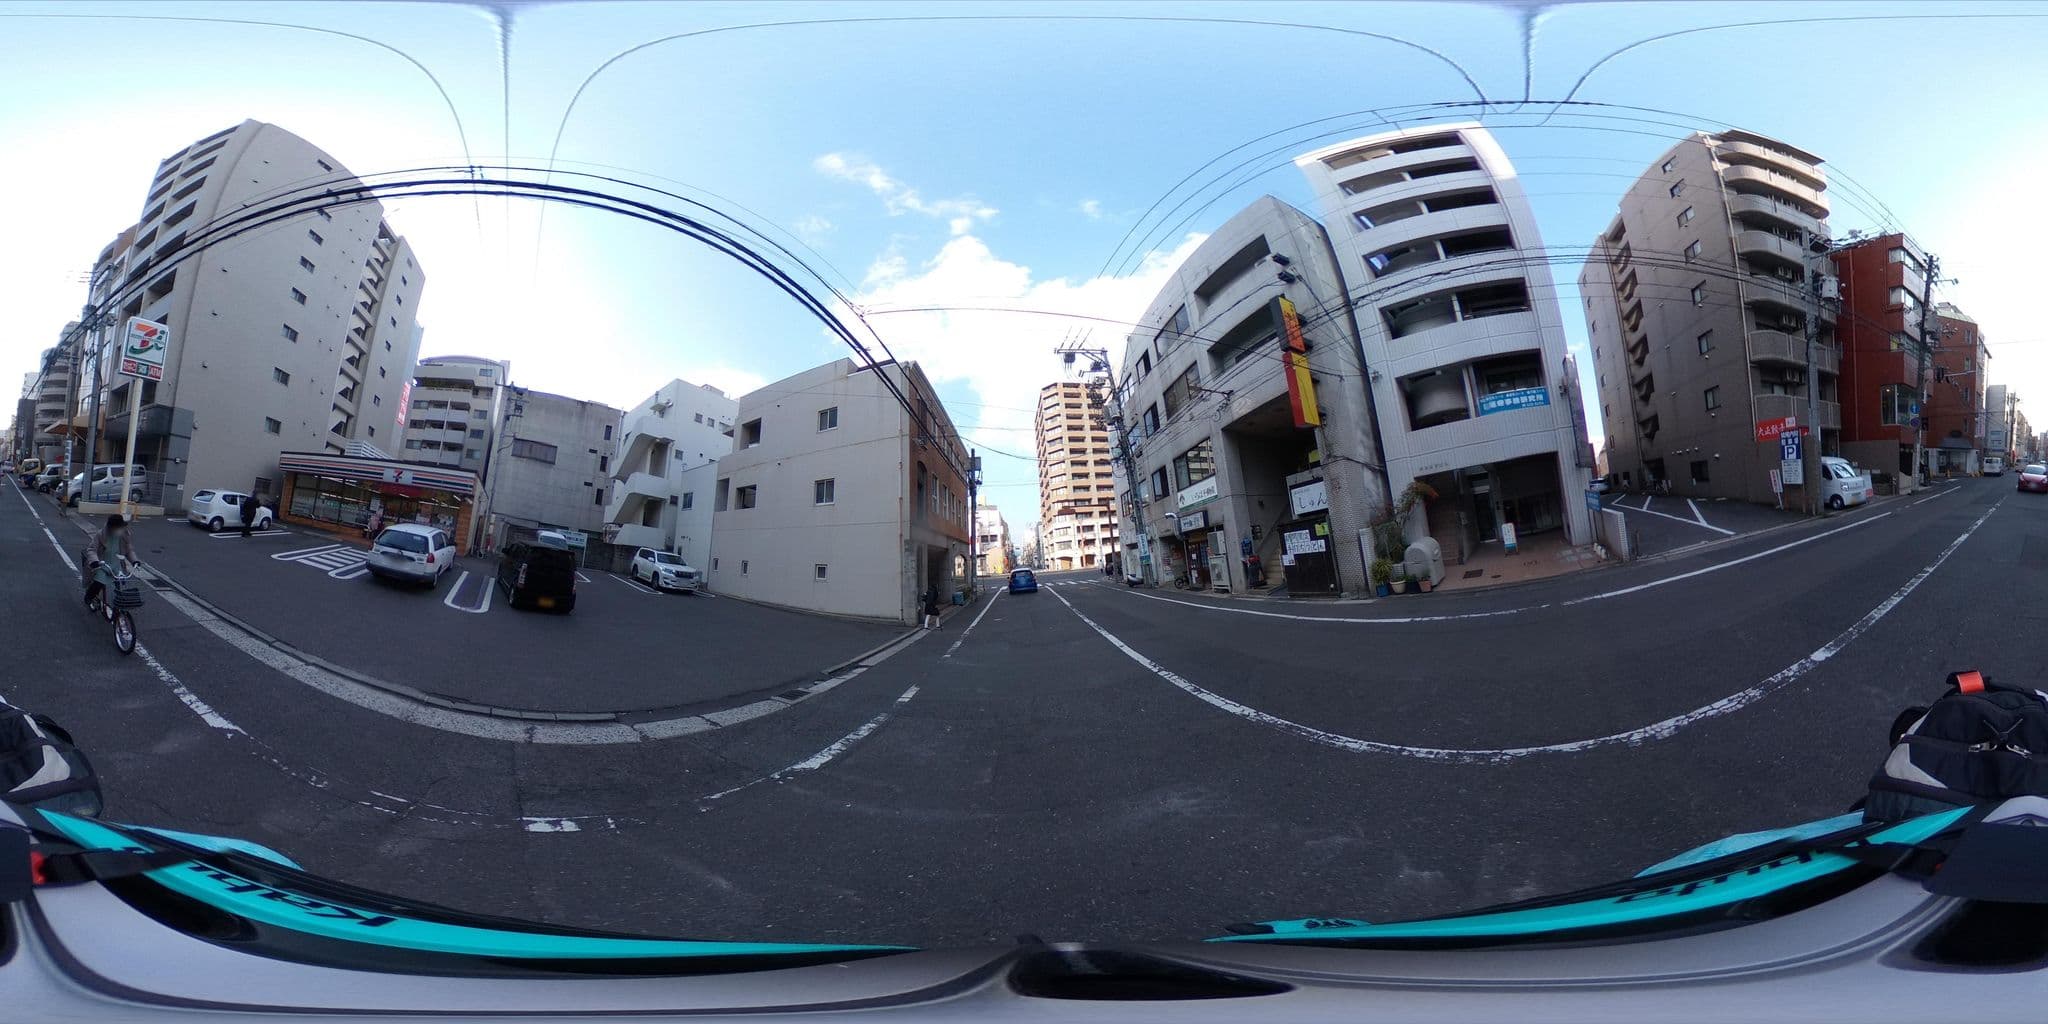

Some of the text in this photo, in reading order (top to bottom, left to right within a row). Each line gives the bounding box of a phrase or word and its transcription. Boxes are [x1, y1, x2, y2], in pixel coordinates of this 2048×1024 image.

[1786, 446, 1795, 459] P
[1299, 492, 1326, 509] しゅん
